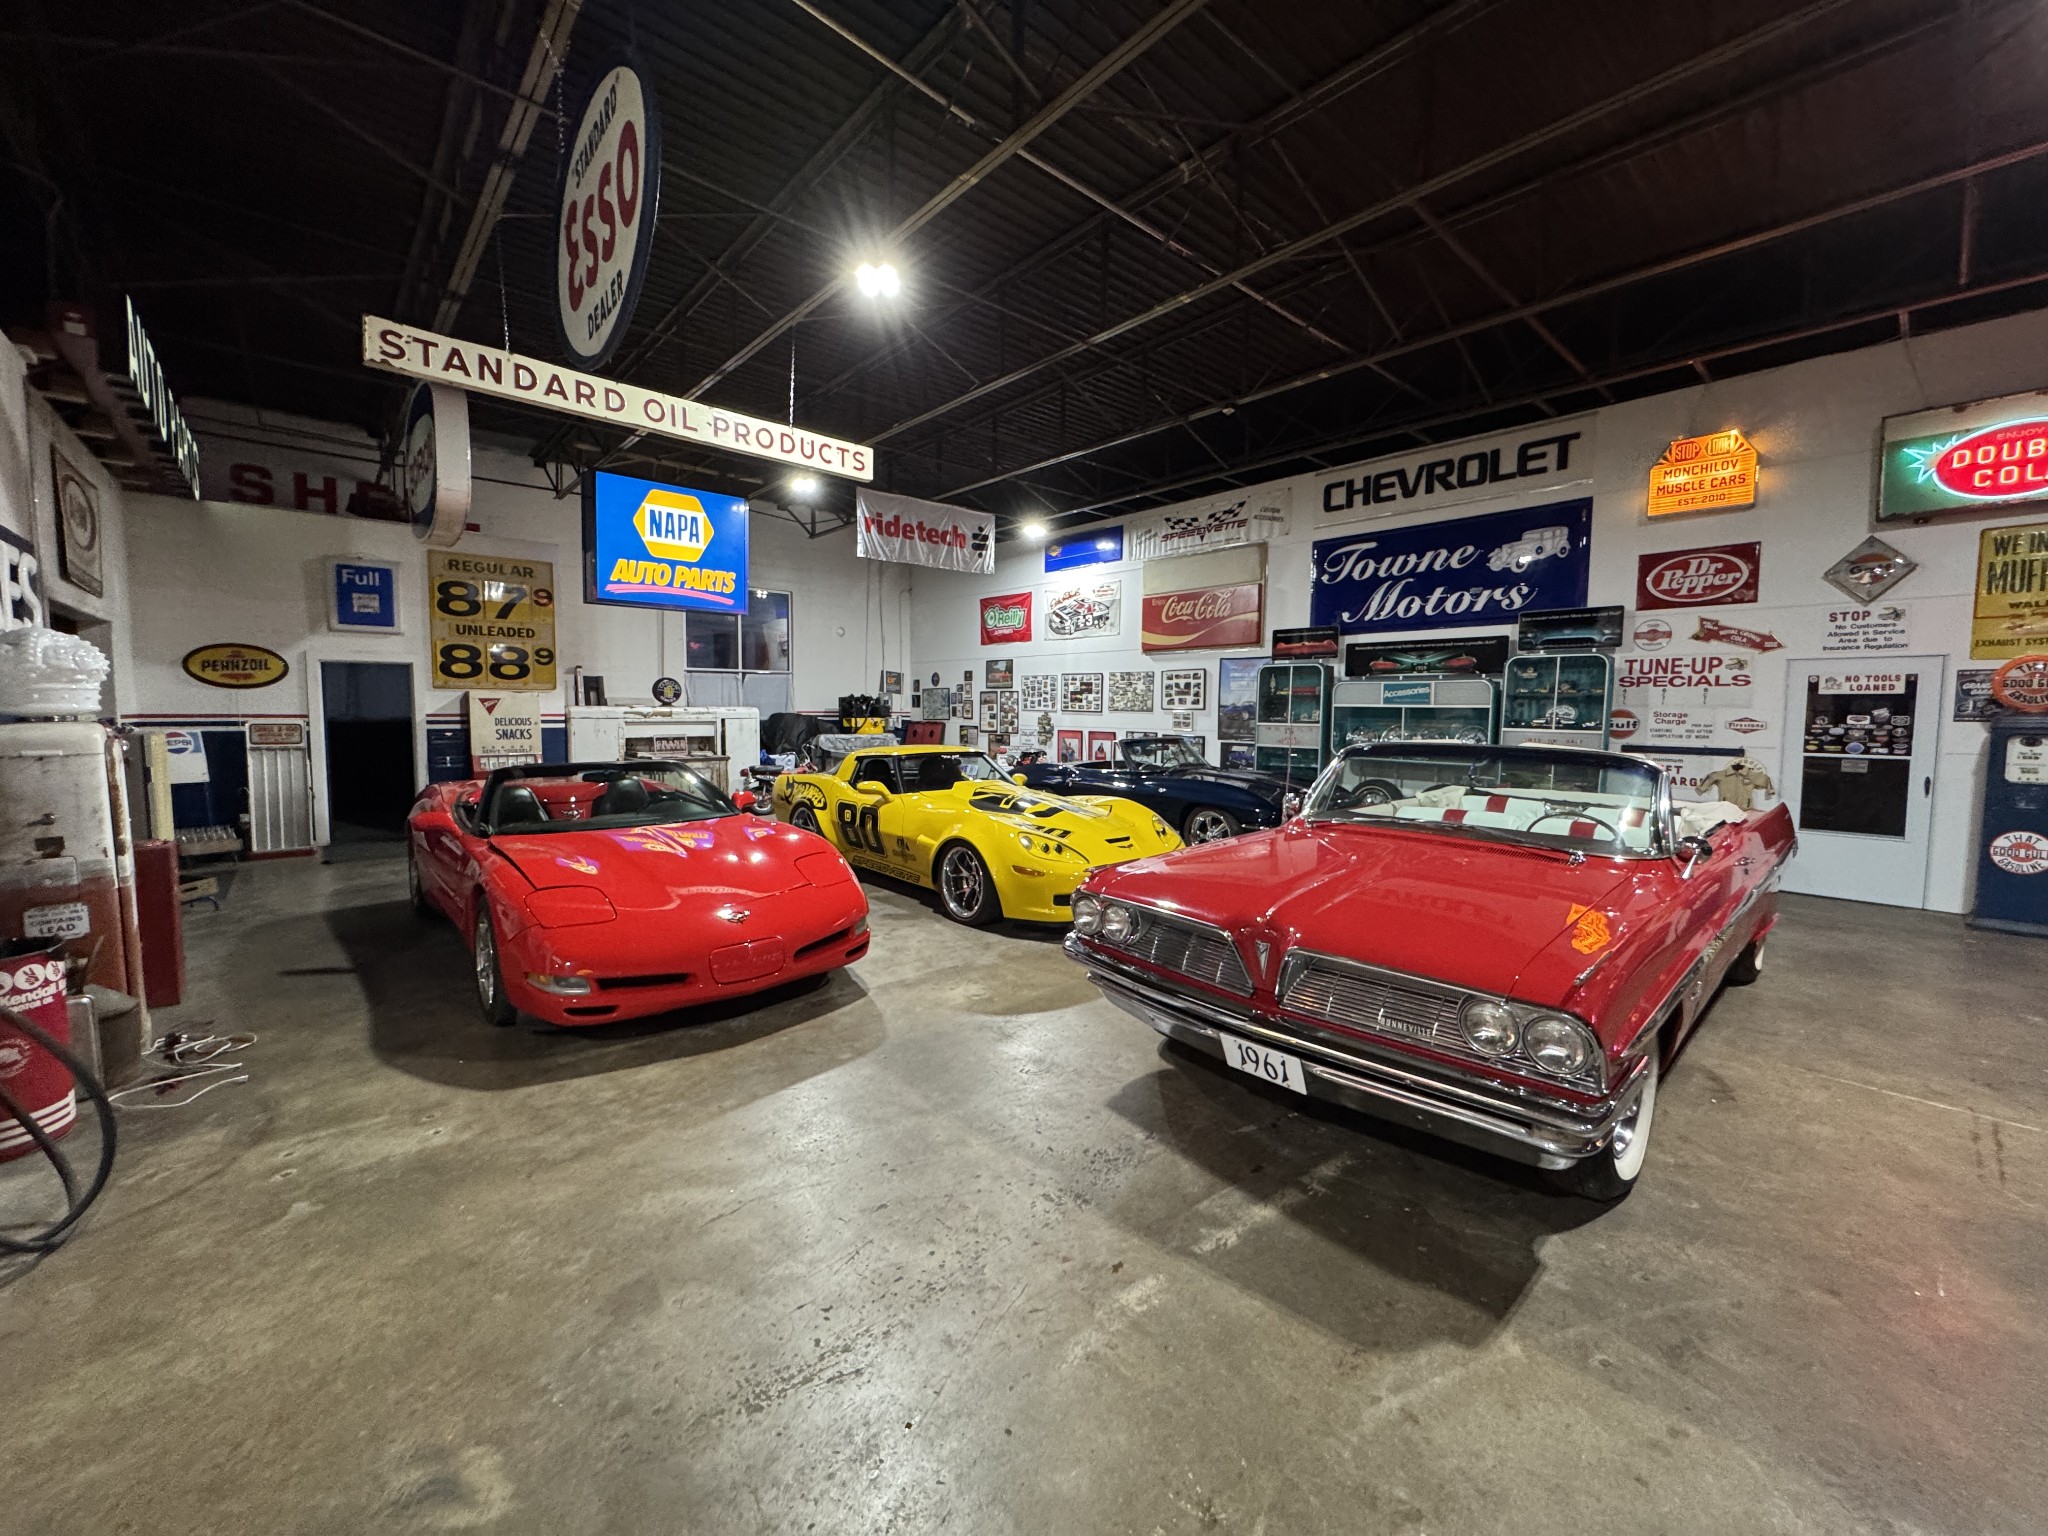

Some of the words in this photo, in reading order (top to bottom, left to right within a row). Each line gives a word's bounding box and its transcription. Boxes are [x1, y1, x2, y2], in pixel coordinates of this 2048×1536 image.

[565, 119, 640, 312] ESSO
[587, 269, 624, 341] DEALER
[379, 329, 626, 413] STANDARD
[643, 398, 698, 432] OIL
[712, 415, 866, 473] PRODUCTS
[1996, 427, 2046, 440] ENJOY
[1674, 441, 1700, 462] STOP
[1706, 436, 1731, 456] LOOK
[1323, 432, 1581, 513] CHEVROLET
[1663, 459, 1739, 480] MONCHILOV
[1974, 463, 2048, 488] COL
[1656, 479, 1706, 497] MUSCLE
[1710, 473, 1747, 489] CARS
[1677, 497, 1698, 507] EST.
[1701, 493, 1726, 503] 2010
[649, 508, 700, 544] NAPA
[864, 512, 967, 549] ridetech
[1993, 533, 2023, 556] WE
[448, 558, 535, 578] REGULAR
[1320, 541, 1484, 585] Towne
[1683, 557, 1723, 577] Dr
[341, 568, 380, 586] Full
[610, 558, 672, 586] AUTO
[673, 565, 736, 594] PARTS
[1656, 569, 1742, 596] Pepper
[1341, 577, 1538, 624] Motors
[2008, 600, 2048, 609] WAL
[984, 603, 1026, 629] O'Reilly
[1829, 610, 1872, 622] STOP
[455, 624, 535, 639] UNLEADED
[1850, 622, 1897, 630] Customers
[1863, 642, 1909, 651] Regulation
[1974, 638, 2021, 648] EXHAUST
[201, 657, 272, 672] PENNZOIL
[1624, 656, 1724, 675] TUNE-UP
[1618, 675, 1752, 688] SPECIALS
[1864, 674, 1902, 682] TOOLS
[2002, 679, 2034, 688] GOOD
[1383, 686, 1430, 698] Accessories
[1849, 684, 1896, 692] LOANED
[494, 717, 532, 726] DELICIOUS
[1653, 711, 1689, 719] Storage
[494, 728, 533, 740] SNACKS
[835, 799, 888, 858] 80
[2003, 834, 2043, 846] THAT
[1993, 846, 2021, 857] GOOD
[2024, 849, 2048, 860] GUL
[1997, 857, 2046, 873] GASOLINE
[39, 923, 76, 936] LEAD
[1379, 1016, 1433, 1037] BONNEVILLE
[1237, 1043, 1290, 1083] 1961
